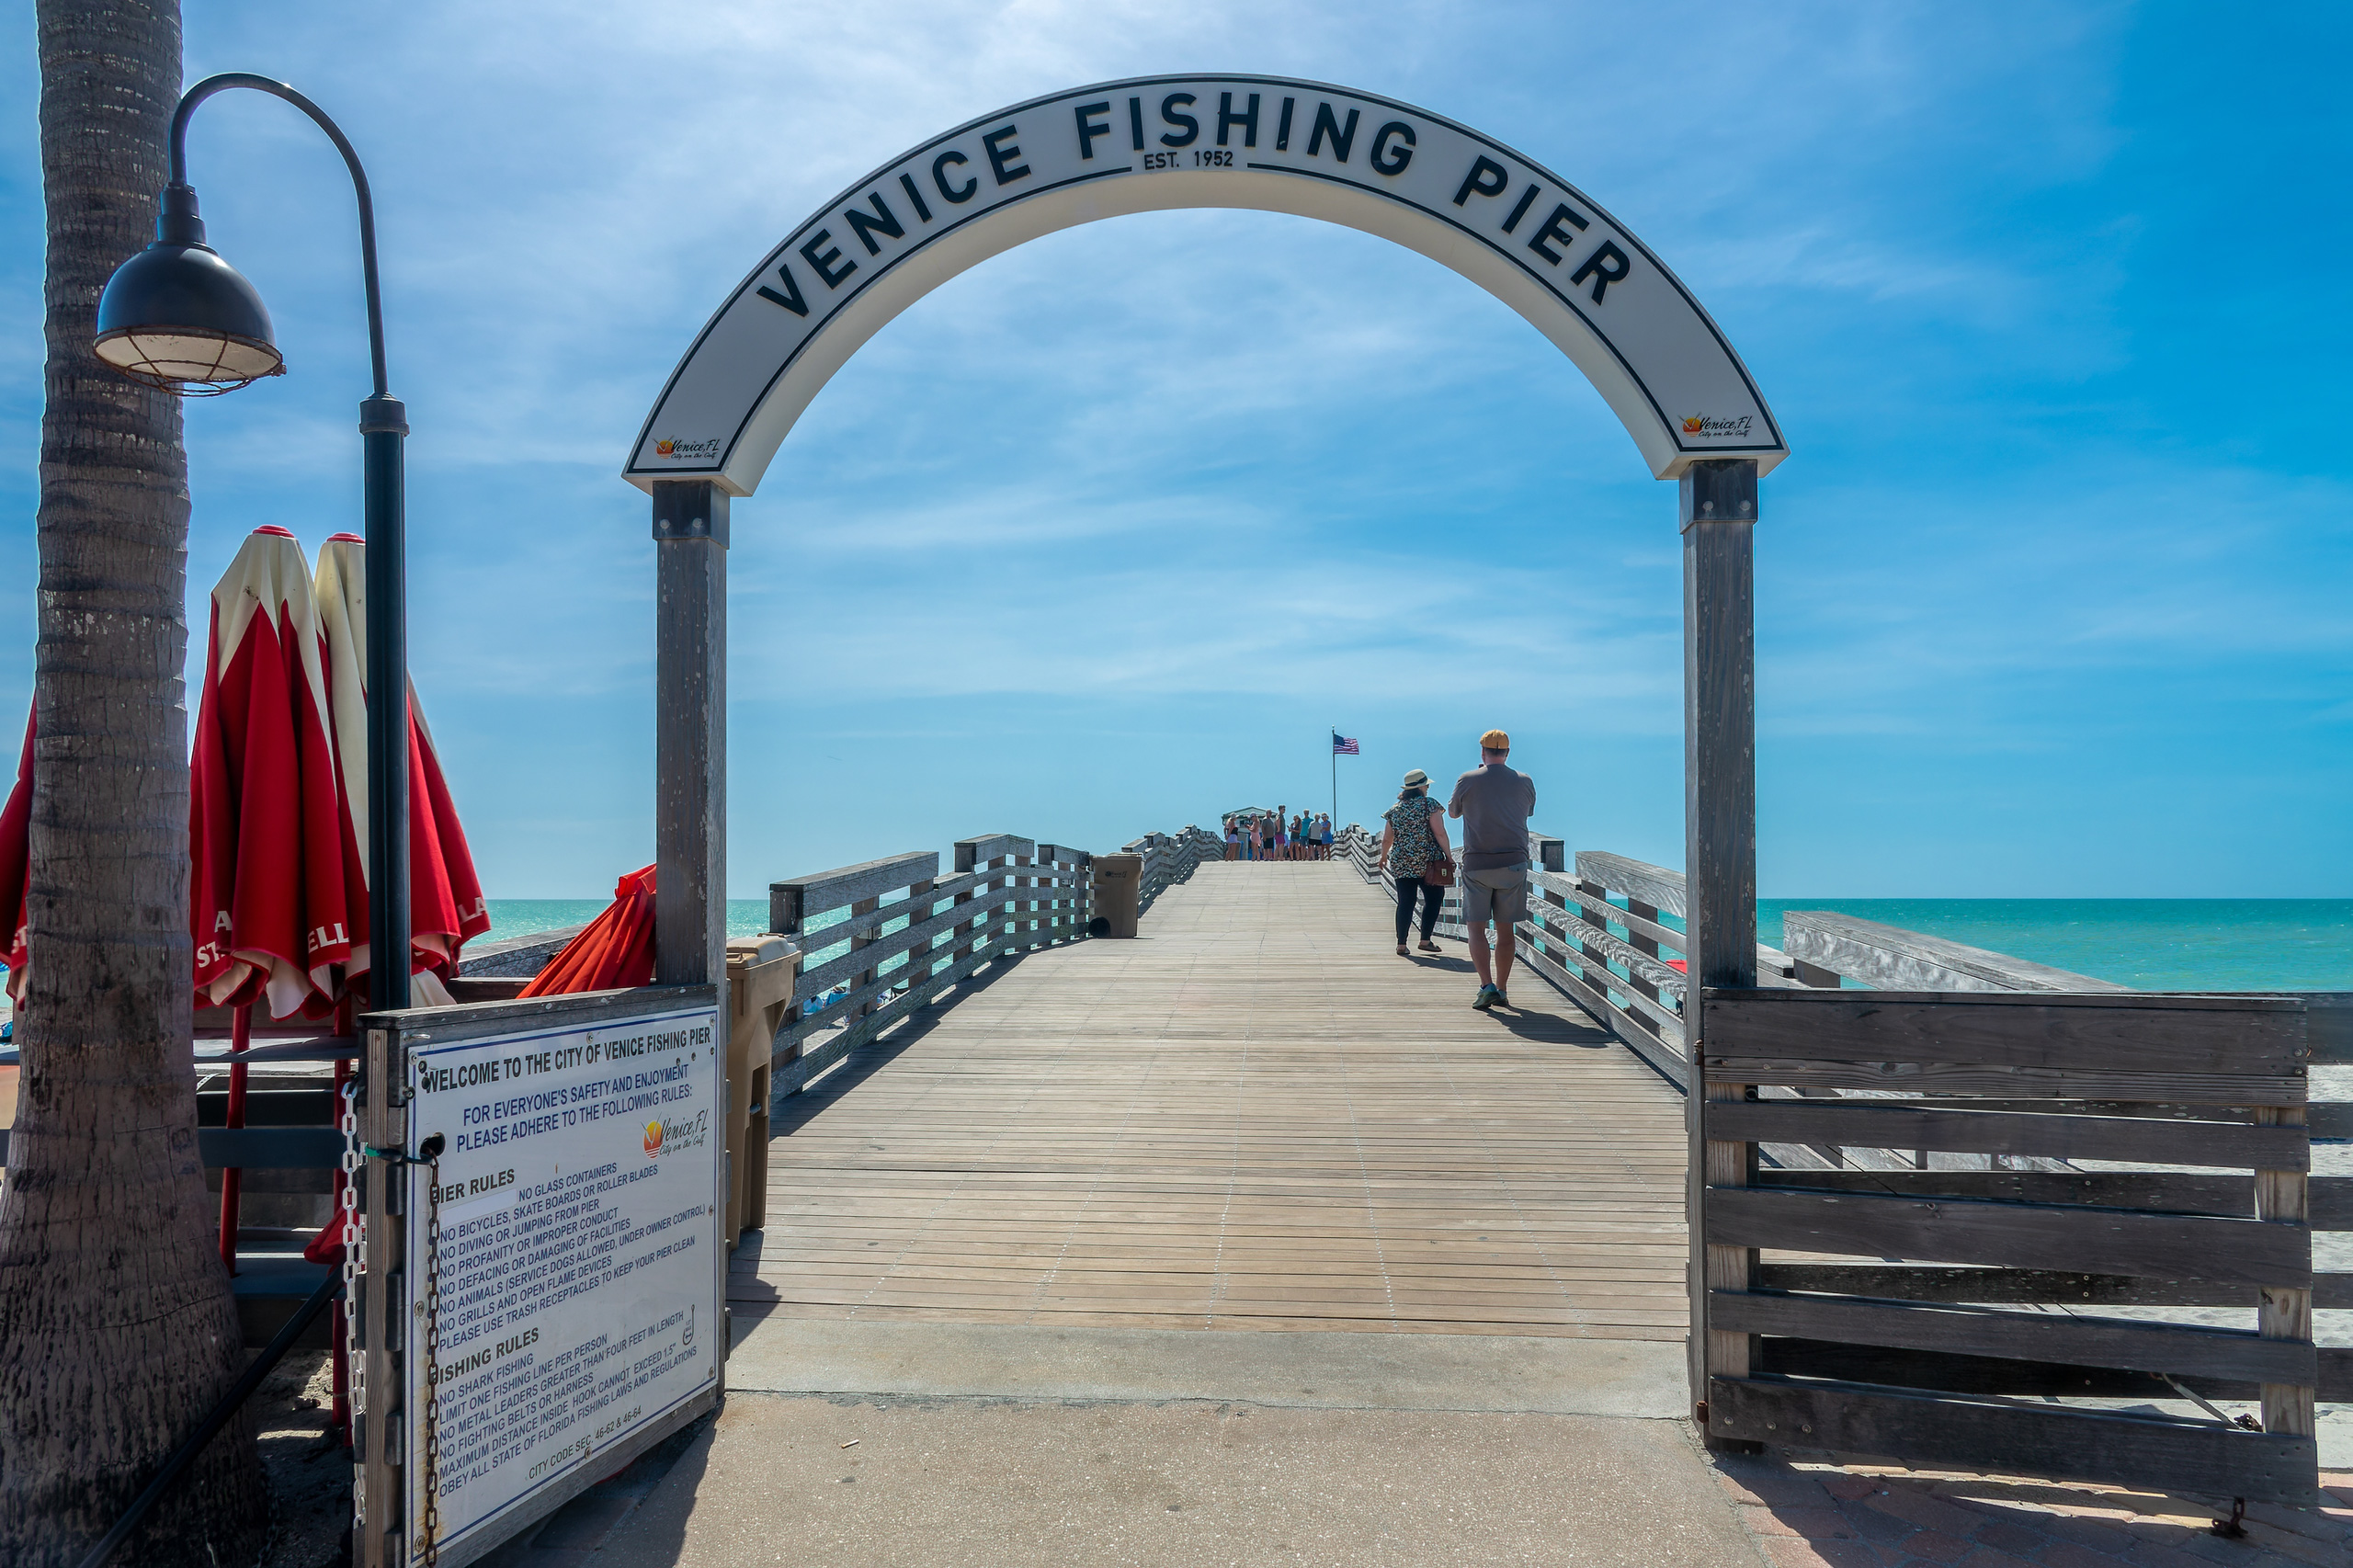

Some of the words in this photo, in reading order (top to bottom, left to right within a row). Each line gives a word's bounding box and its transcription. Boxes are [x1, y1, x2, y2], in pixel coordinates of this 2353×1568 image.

[1143, 152, 1179, 170] EST.
[1194, 150, 1233, 167] 1952
[756, 124, 1031, 318] VENICE
[1074, 92, 1417, 176] FISHING
[1452, 154, 1631, 305] PIER
[1699, 429, 1711, 438] City
[426, 1061, 499, 1093] WELCOME
[504, 1057, 521, 1078] TO
[525, 1052, 551, 1074] THE
[555, 1047, 582, 1069] CITY
[585, 1044, 600, 1063] OF
[604, 1037, 643, 1060] VENICE
[647, 1030, 687, 1052] FISHING
[689, 1027, 710, 1045] PIER
[463, 1105, 490, 1126] FOR
[494, 1089, 567, 1119] EVERYONE'S
[571, 1080, 610, 1102] SAFETY
[611, 1076, 632, 1094] AND
[635, 1064, 688, 1088] ENJOYMENT
[457, 1125, 507, 1153] PLEASE
[511, 1113, 558, 1140] ADHERE
[562, 1109, 576, 1127] TO
[579, 1104, 599, 1122] THE
[602, 1091, 658, 1118] FOLLOWING
[661, 1084, 692, 1103] RULES:
[659, 1144, 672, 1156] City
[673, 1142, 681, 1153] on
[683, 1138, 691, 1149] the
[440, 1228, 456, 1243] NO
[459, 1211, 510, 1237] BICYCLES,
[513, 1200, 542, 1220] SKATE
[545, 1188, 581, 1210] BOARDS
[583, 1185, 595, 1197] OR
[597, 1174, 628, 1193] ROLLER
[630, 1165, 657, 1182] BLADES
[470, 1169, 515, 1195] RULES
[518, 1187, 532, 1201] NO
[535, 1178, 563, 1196] GLASS
[566, 1163, 617, 1187] CONTAINERS
[439, 1264, 455, 1279] NO
[459, 1243, 515, 1273] PROFANITY
[517, 1238, 530, 1252] OR
[533, 1221, 577, 1246] IMPROPER
[579, 1207, 618, 1230] CONDUCT
[439, 1282, 455, 1298] NO
[459, 1262, 508, 1290] DEFACING
[512, 1256, 525, 1270] OR
[528, 1238, 574, 1265] DAMAGING
[576, 1233, 587, 1246] OF
[590, 1218, 630, 1242] FACILITIES
[439, 1300, 455, 1315] NO
[457, 1281, 503, 1309] ANIMALS
[506, 1264, 548, 1293] (SERVICE
[550, 1255, 574, 1273] DOGS
[576, 1239, 617, 1263] ALLOWED,
[619, 1228, 644, 1245] UNDER
[645, 1217, 671, 1235] OWNER
[673, 1204, 706, 1224] CONTROL)
[440, 1246, 455, 1261] NO
[459, 1233, 493, 1255] DIVING
[495, 1228, 509, 1242] OR
[512, 1214, 552, 1237] JUMPING
[555, 1205, 578, 1222] FROM
[581, 1199, 599, 1213] PIER
[439, 1324, 481, 1352] PLEASE
[483, 1314, 503, 1333] USE
[506, 1301, 537, 1324] TRASH
[540, 1276, 599, 1310] RECEPTACLES
[601, 1270, 611, 1283] TO
[614, 1262, 633, 1278] KEEP
[635, 1253, 654, 1268] YOUR
[656, 1245, 672, 1260] PIER
[673, 1235, 695, 1252] CLEAN
[439, 1318, 455, 1334] NO
[458, 1301, 494, 1325] GRILLS
[496, 1293, 517, 1311] AND
[519, 1281, 544, 1301] OPEN
[548, 1269, 575, 1290] FLAME
[578, 1256, 611, 1278] DEVICES
[439, 1426, 455, 1443] NO
[459, 1408, 492, 1434] METAL
[494, 1384, 538, 1415] LEADERS
[540, 1363, 580, 1392] GREATER
[583, 1350, 604, 1369] THAN
[606, 1339, 627, 1358] FOUR
[629, 1329, 646, 1346] FEET
[648, 1324, 654, 1336] IN
[656, 1311, 683, 1333] LENGTH
[496, 1327, 539, 1358] RULES
[439, 1390, 455, 1406] NO
[458, 1370, 494, 1397] SHARK
[496, 1353, 533, 1380] FISHING
[439, 1401, 467, 1425] LIMIT
[470, 1390, 491, 1409] ONE
[494, 1371, 530, 1398] FISHING
[533, 1359, 552, 1379] LINE
[555, 1351, 572, 1369] PER
[574, 1334, 607, 1358] PERSON
[439, 1443, 489, 1480] MAXIMUM
[492, 1417, 538, 1451] DISTANCE
[540, 1400, 568, 1425] INSIDE
[573, 1385, 596, 1407] HOOK
[598, 1368, 630, 1392] CANNOT
[634, 1351, 662, 1374] EXCEED
[439, 1444, 455, 1461] NO
[459, 1418, 505, 1451] FIGHTING
[507, 1402, 536, 1426] BELTS
[539, 1393, 551, 1408] OR
[554, 1372, 593, 1402] HARNESS
[439, 1471, 469, 1496] OBEY
[471, 1461, 489, 1481] ALL
[492, 1442, 521, 1468] STATE
[524, 1434, 536, 1450] OF
[538, 1414, 575, 1442] FLORIDA
[577, 1394, 608, 1420] FISHING
[611, 1381, 632, 1402] LAWS
[633, 1372, 649, 1389] AND
[650, 1346, 697, 1380] REGULATIONS
[529, 1459, 548, 1479] CITY
[551, 1445, 573, 1466] CODE
[575, 1435, 593, 1451] SEC.
[595, 1421, 614, 1439] 46-62
[616, 1417, 621, 1427] &
[623, 1405, 641, 1423] 46-64
